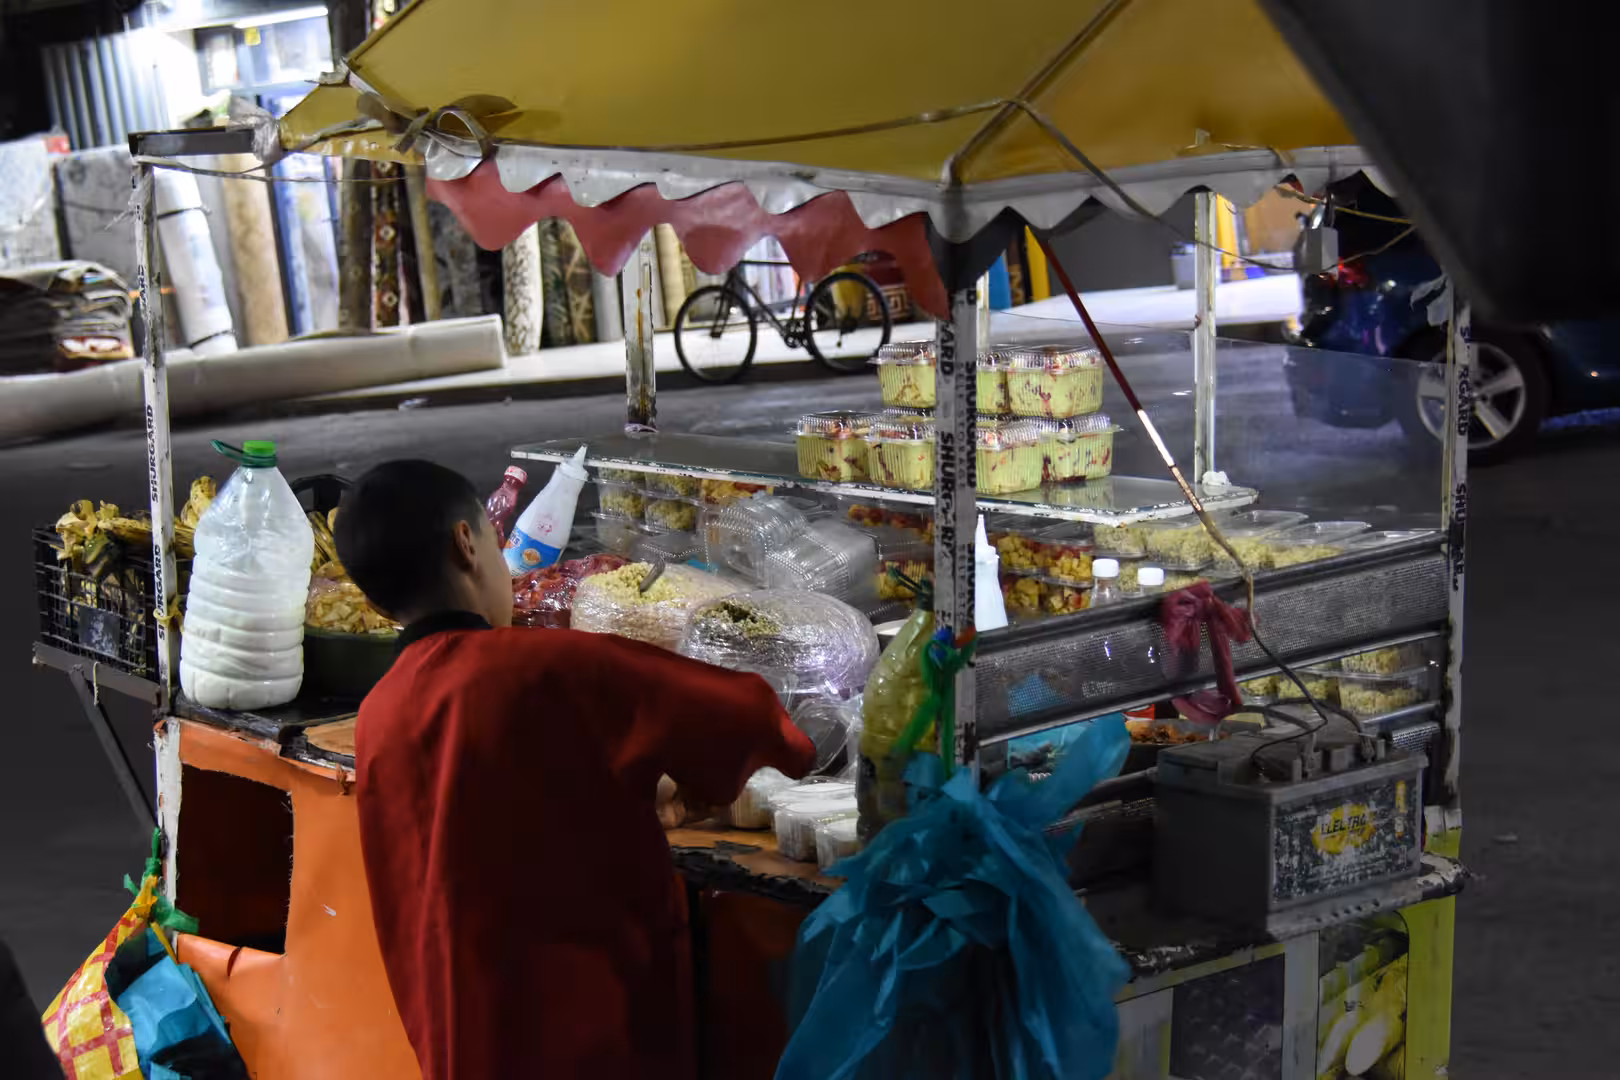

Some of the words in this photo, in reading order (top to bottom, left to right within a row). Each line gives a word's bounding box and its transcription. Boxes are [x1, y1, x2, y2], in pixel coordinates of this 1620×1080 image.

[1457, 326, 1472, 436] SRGARD
[147, 404, 159, 503] SHURGARD
[154, 544, 166, 640] SURGARD
